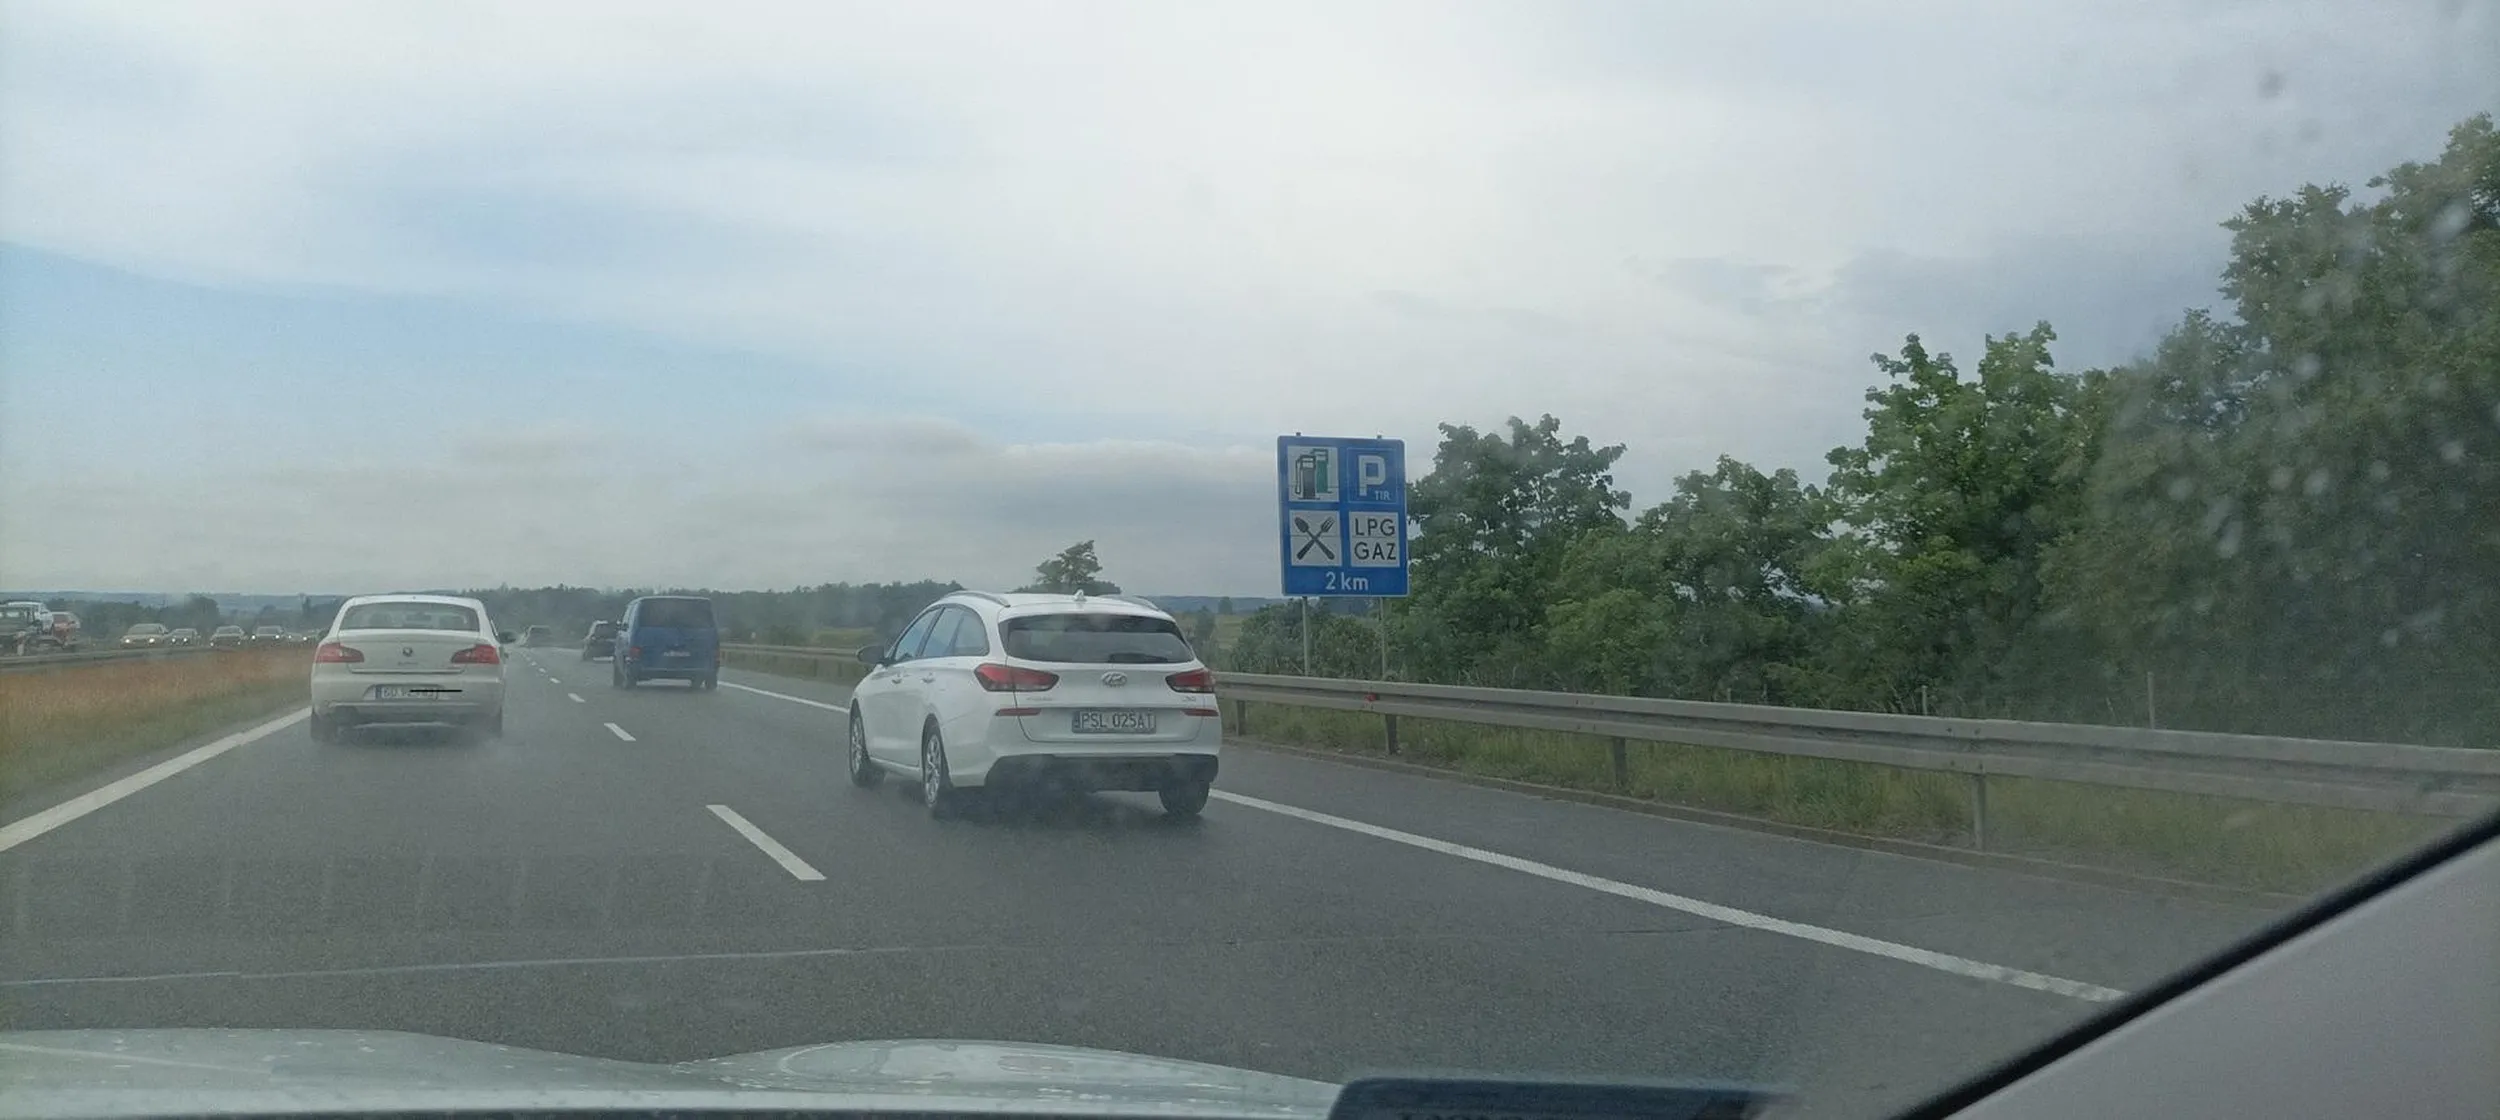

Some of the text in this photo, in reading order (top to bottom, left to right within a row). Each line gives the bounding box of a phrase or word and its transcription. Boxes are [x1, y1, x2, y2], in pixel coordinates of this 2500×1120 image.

[1358, 455, 1386, 496] P
[1375, 491, 1391, 500] TIR
[1355, 518, 1395, 537] LPG
[1354, 542, 1396, 560] GAZ
[1325, 572, 1368, 590] 2 km
[1081, 712, 1107, 728] PSL
